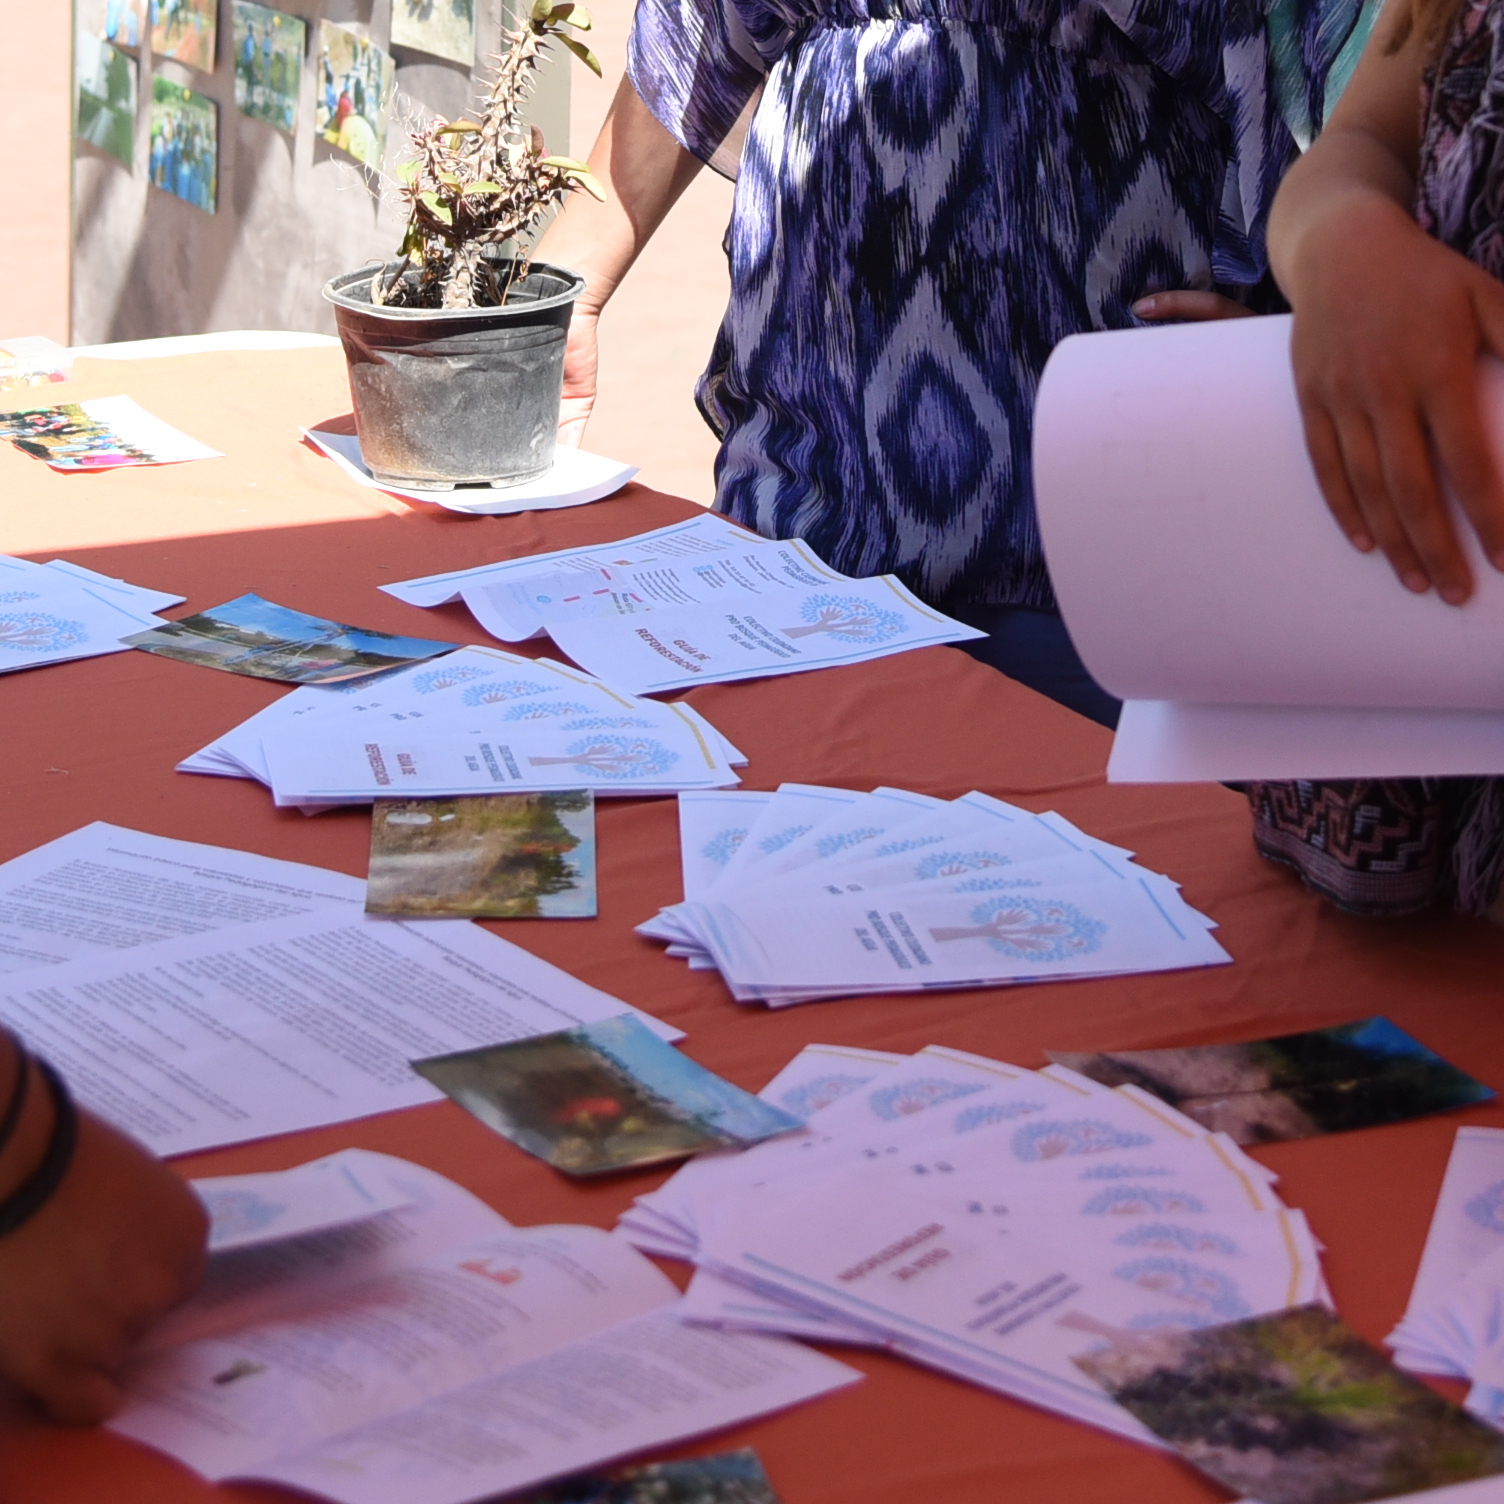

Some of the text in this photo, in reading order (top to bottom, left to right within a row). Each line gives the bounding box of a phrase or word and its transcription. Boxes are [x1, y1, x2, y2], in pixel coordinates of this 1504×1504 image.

[725, 614, 740, 625] PRO
[743, 615, 773, 637] COLECTIVO
[635, 628, 704, 673] REFORESTACIÓN
